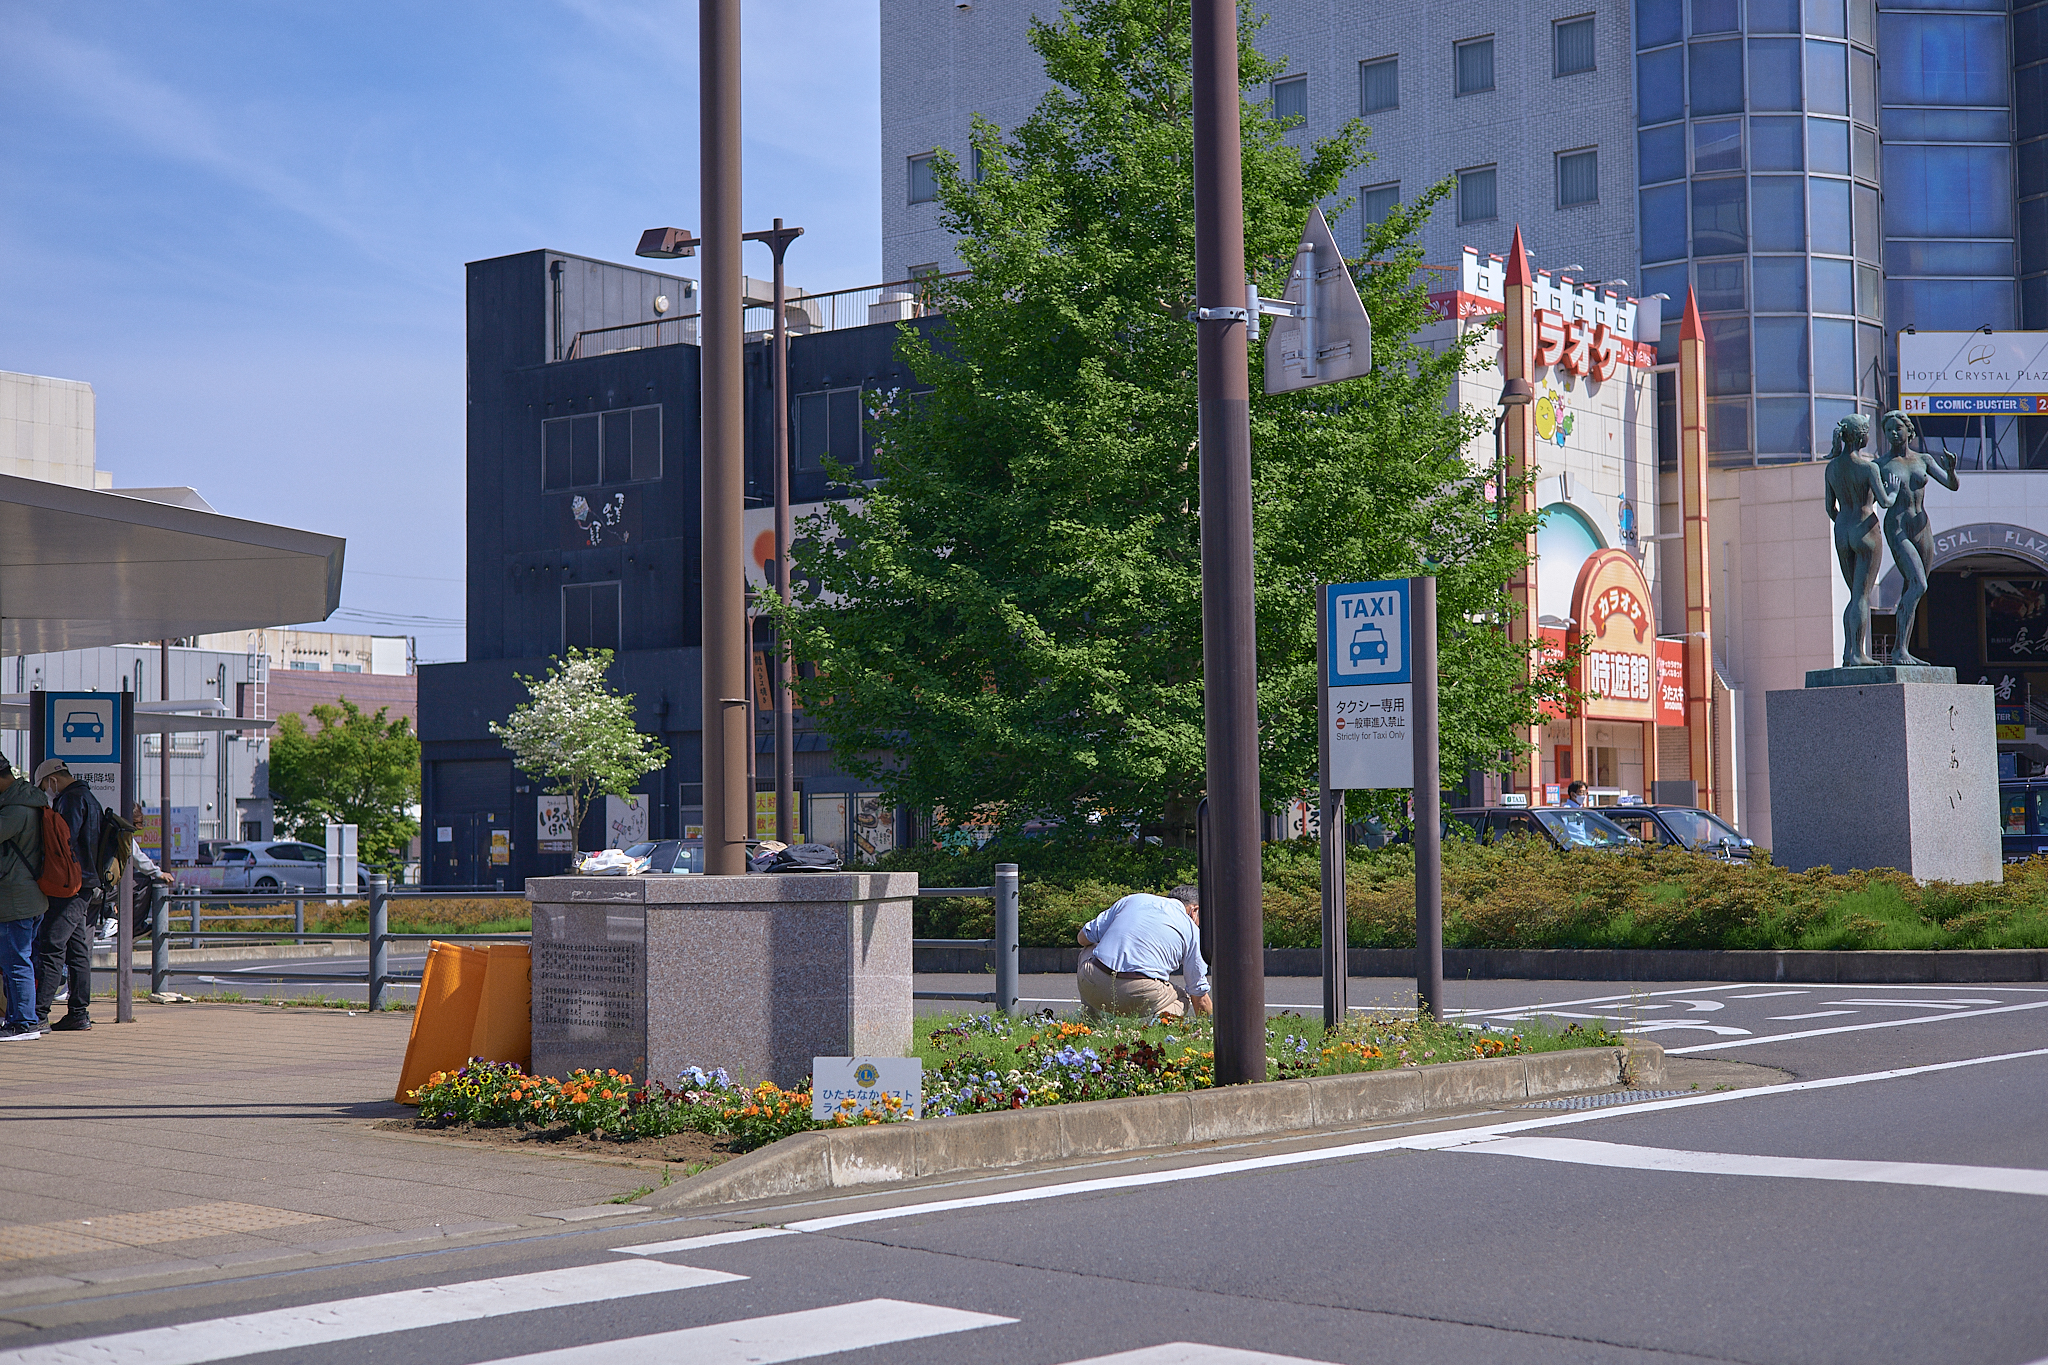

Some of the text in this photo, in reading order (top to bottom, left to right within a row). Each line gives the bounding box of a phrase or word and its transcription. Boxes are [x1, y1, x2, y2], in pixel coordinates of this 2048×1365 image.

[1538, 309, 1622, 382] ラオケ
[1906, 370, 1948, 381] HOTEL
[1955, 370, 2010, 381] CRYSTAL
[2038, 399, 2048, 411] 2
[1341, 596, 1394, 619] TAXI
[1598, 589, 1641, 619] カラオケ
[1591, 651, 1649, 699] 時遊館
[1662, 684, 1684, 701] うたスキ
[1336, 698, 1405, 715] タクシー専用
[1346, 716, 1405, 729] 一般車進入禁止
[1336, 731, 1405, 741] Strictly for Taxi Only
